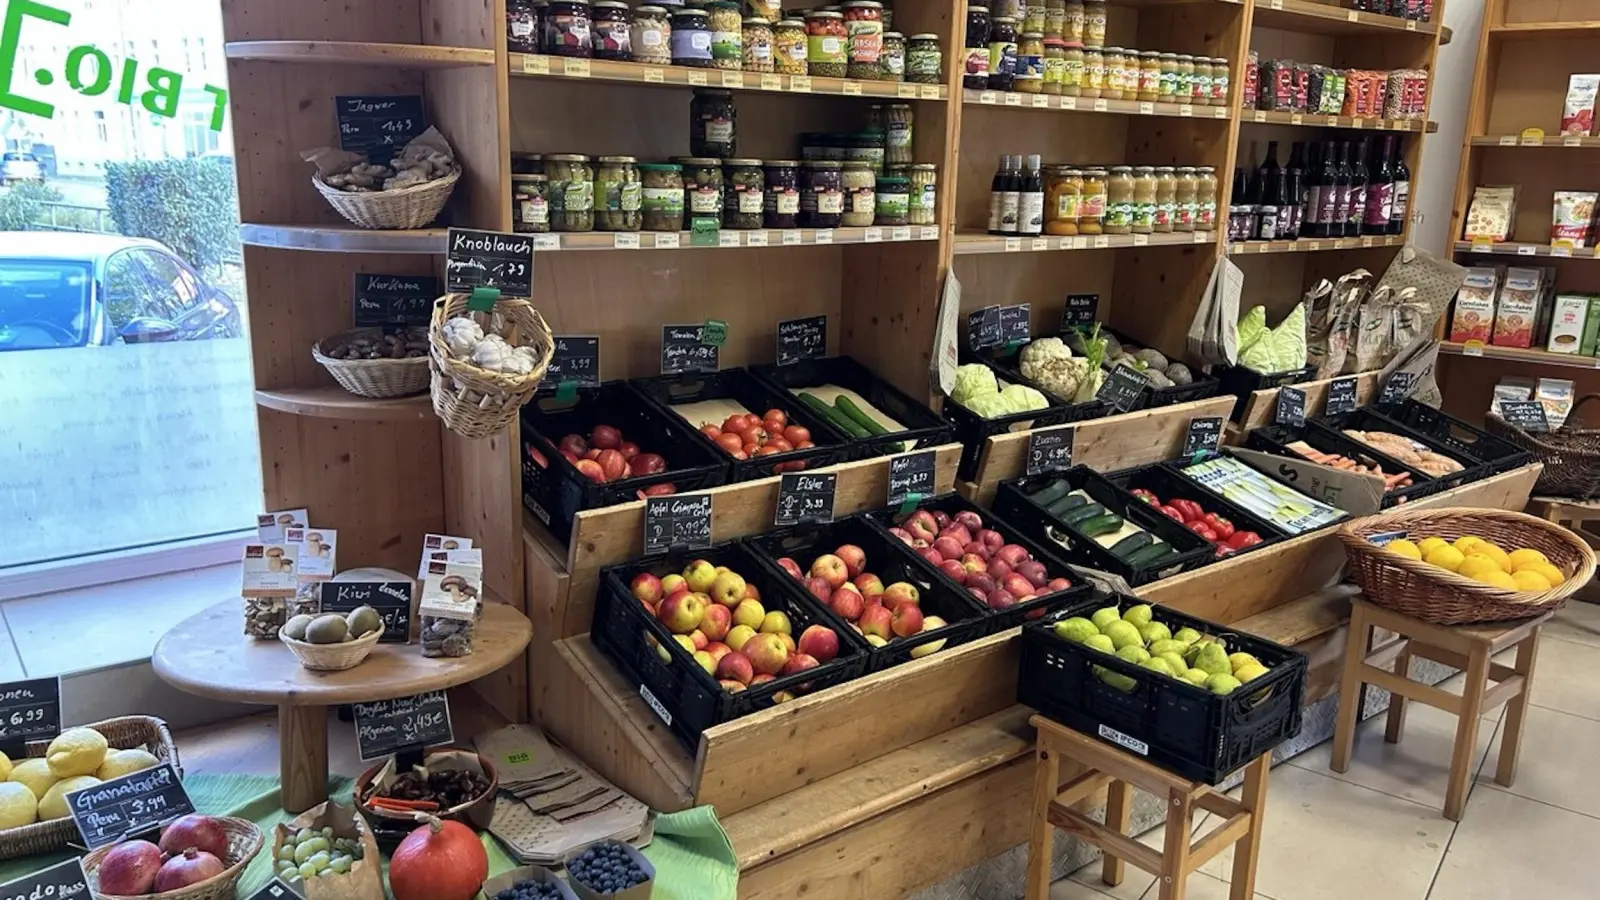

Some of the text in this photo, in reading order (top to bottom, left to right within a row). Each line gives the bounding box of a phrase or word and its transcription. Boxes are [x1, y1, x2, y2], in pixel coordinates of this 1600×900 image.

[453, 233, 531, 255] Knoblauch
[649, 501, 669, 517] Apfel
[336, 585, 372, 602] Kiwi
[0, 689, 35, 702] onen
[10, 708, 44, 726] 6,99
[86, 812, 121, 828] Peru
